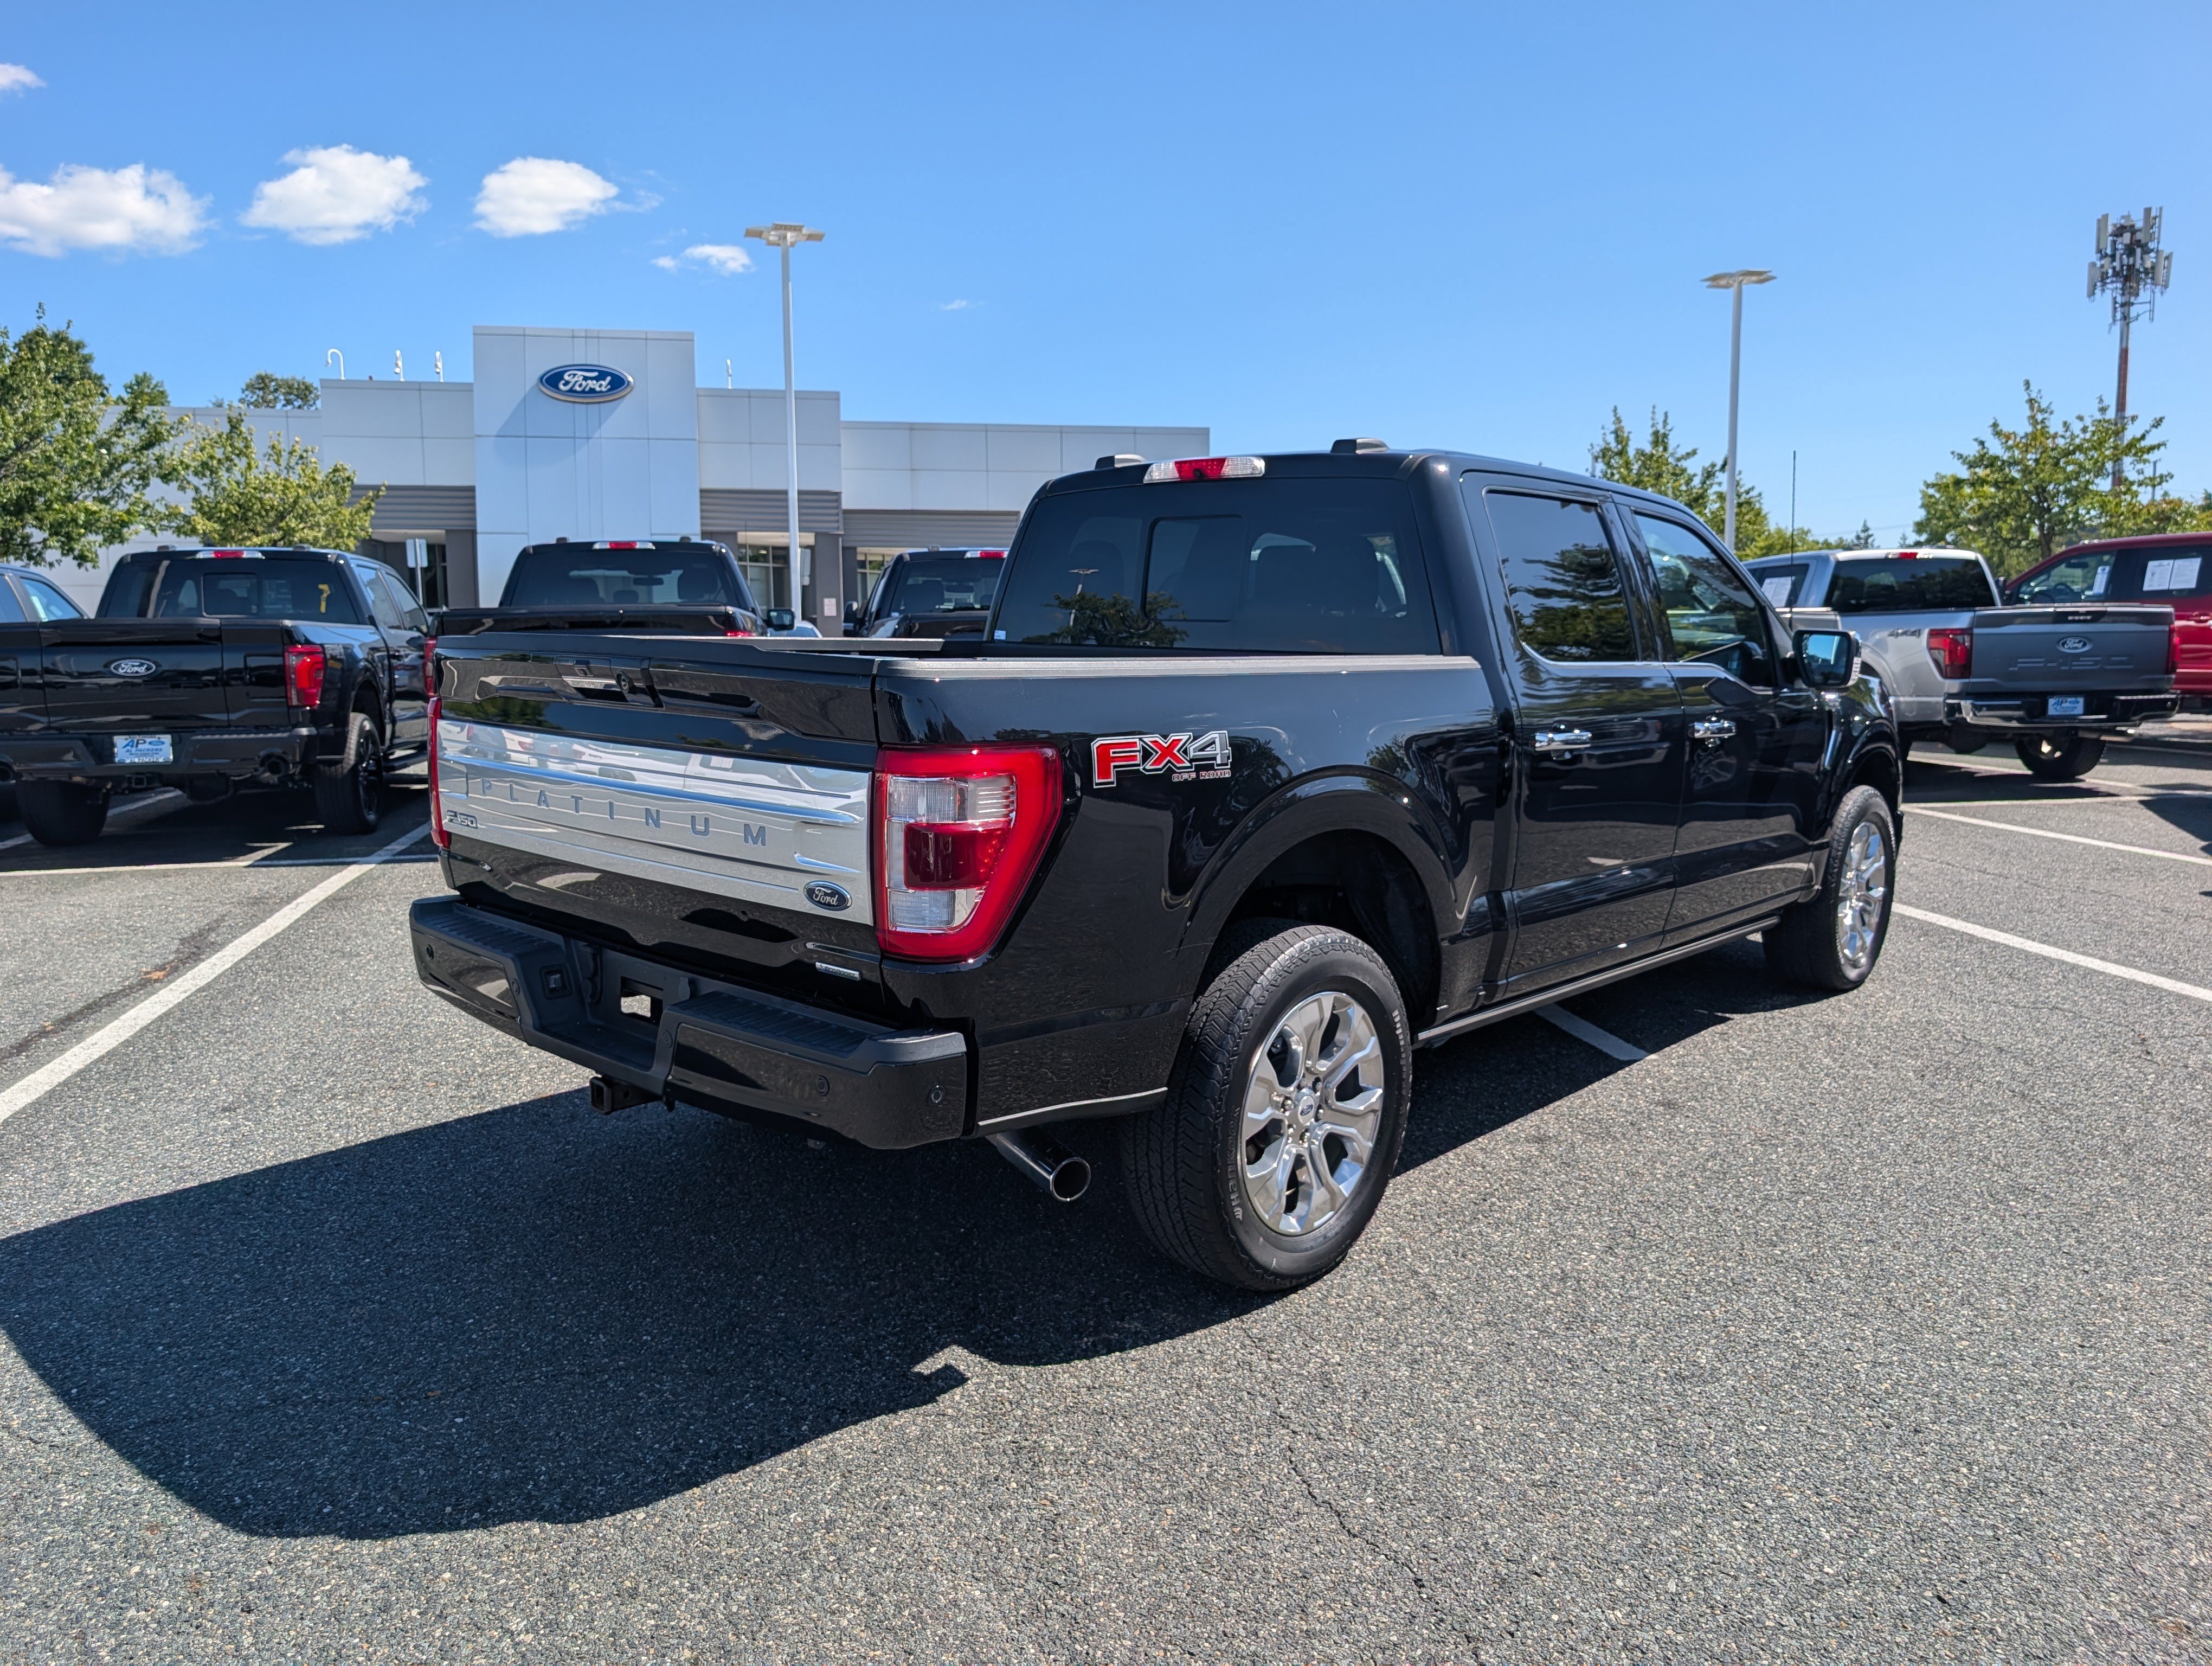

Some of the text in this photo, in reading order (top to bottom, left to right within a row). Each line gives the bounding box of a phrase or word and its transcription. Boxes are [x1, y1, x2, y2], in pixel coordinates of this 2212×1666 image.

[558, 370, 612, 392] Ford
[2064, 638, 2084, 649] Ford
[118, 661, 147, 673] Ford
[122, 739, 147, 749] AP
[1091, 731, 1232, 789] FX4
[1172, 769, 1231, 782] OFF ROAD
[481, 778, 767, 847] PLATINUM
[814, 887, 838, 906] Ford
